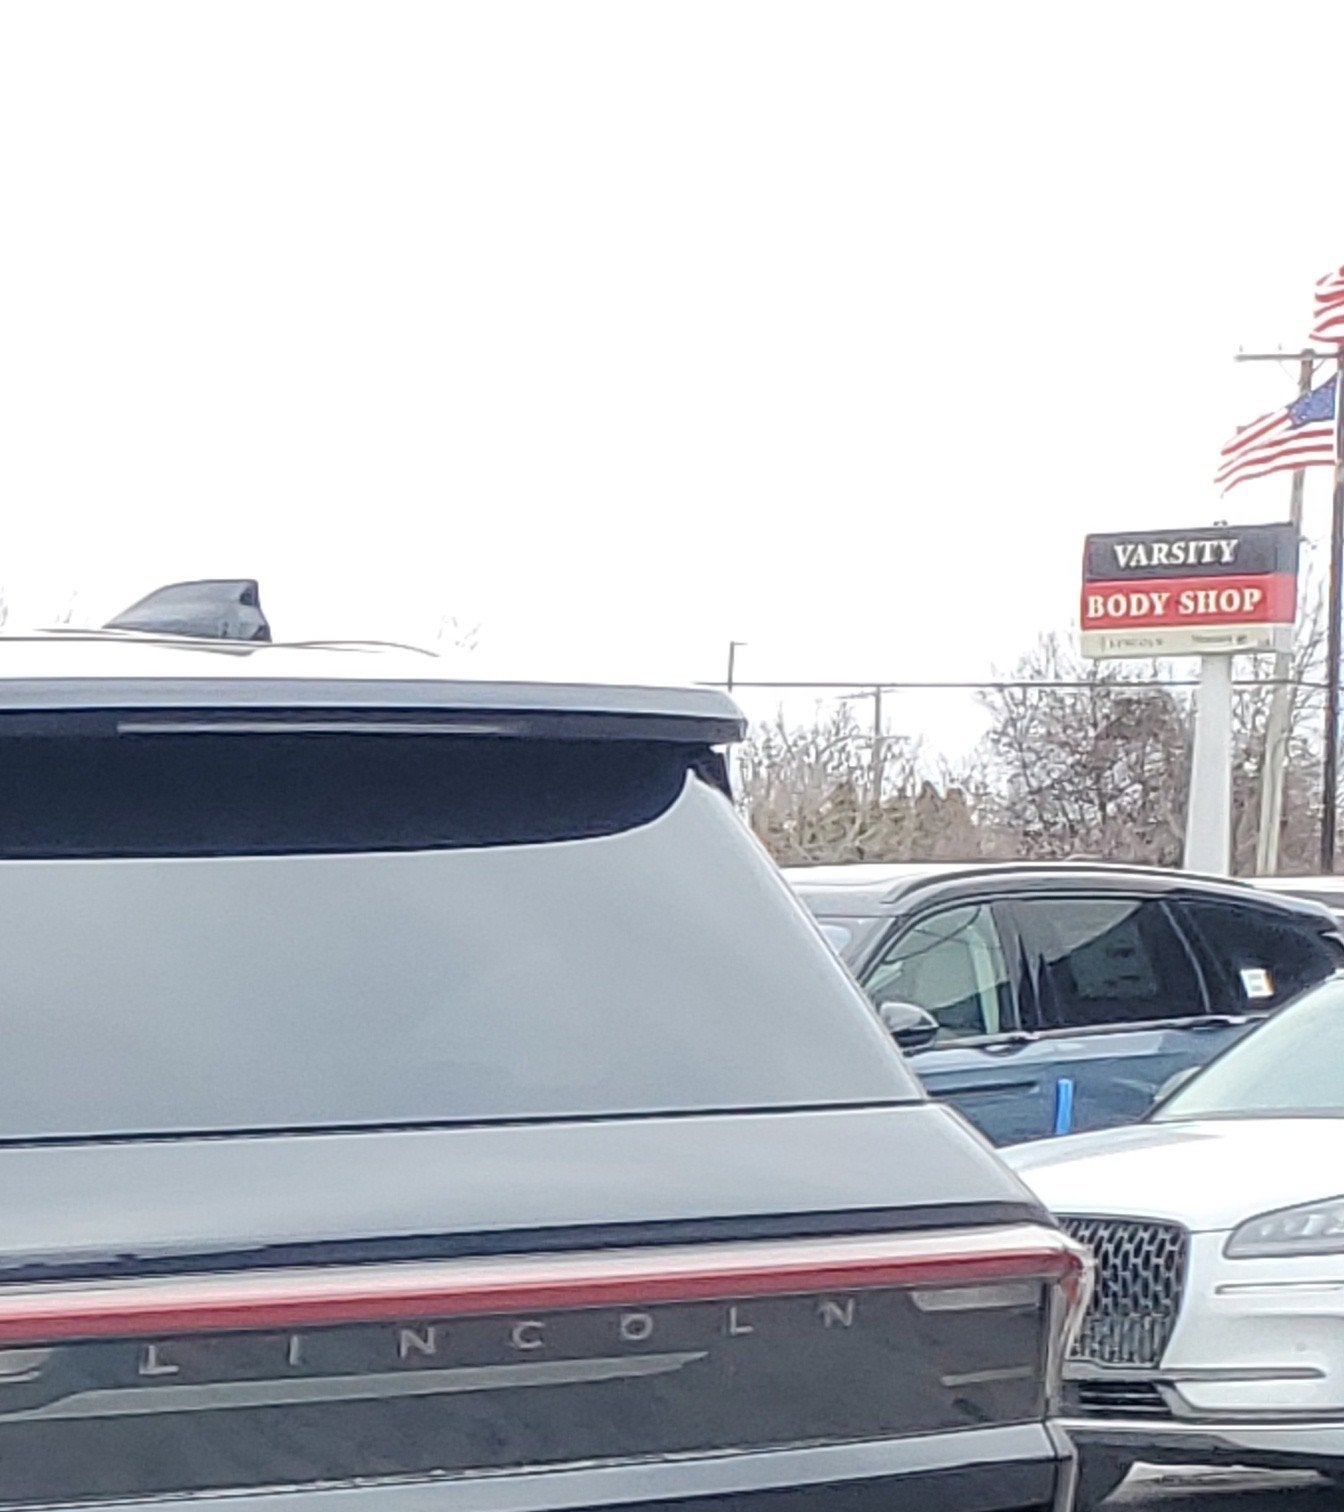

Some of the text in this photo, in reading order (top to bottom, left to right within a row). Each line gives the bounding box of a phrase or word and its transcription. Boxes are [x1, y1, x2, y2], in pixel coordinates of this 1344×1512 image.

[1114, 539, 1238, 568] VARSITY
[1088, 588, 1262, 618] BODY SHOP
[138, 1298, 854, 1375] LINCOLN
